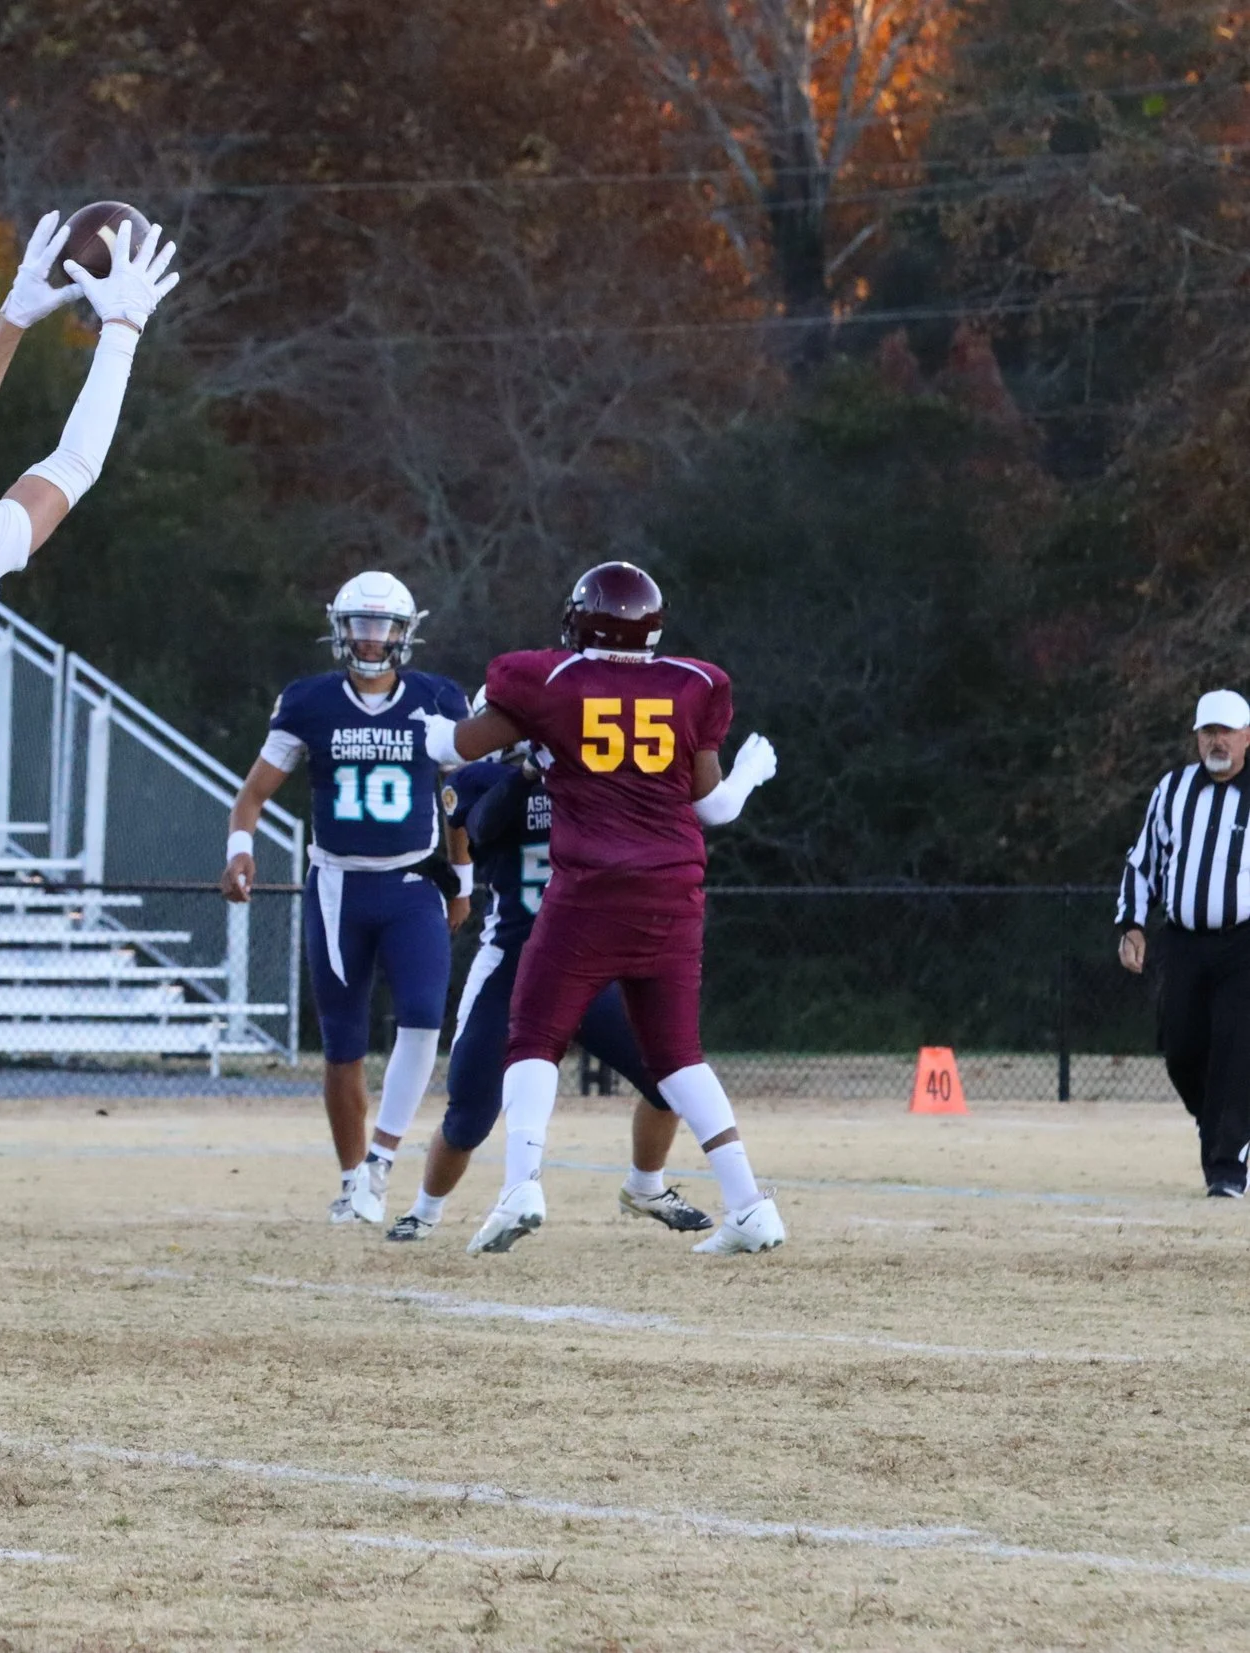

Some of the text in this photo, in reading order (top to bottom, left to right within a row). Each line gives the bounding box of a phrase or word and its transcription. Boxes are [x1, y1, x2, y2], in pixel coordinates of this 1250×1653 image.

[331, 727, 414, 746] ASHEVILLE
[581, 697, 675, 773] 55
[331, 745, 414, 762] CHRISTIAN
[333, 764, 413, 823] 10
[925, 1069, 951, 1101] 40
